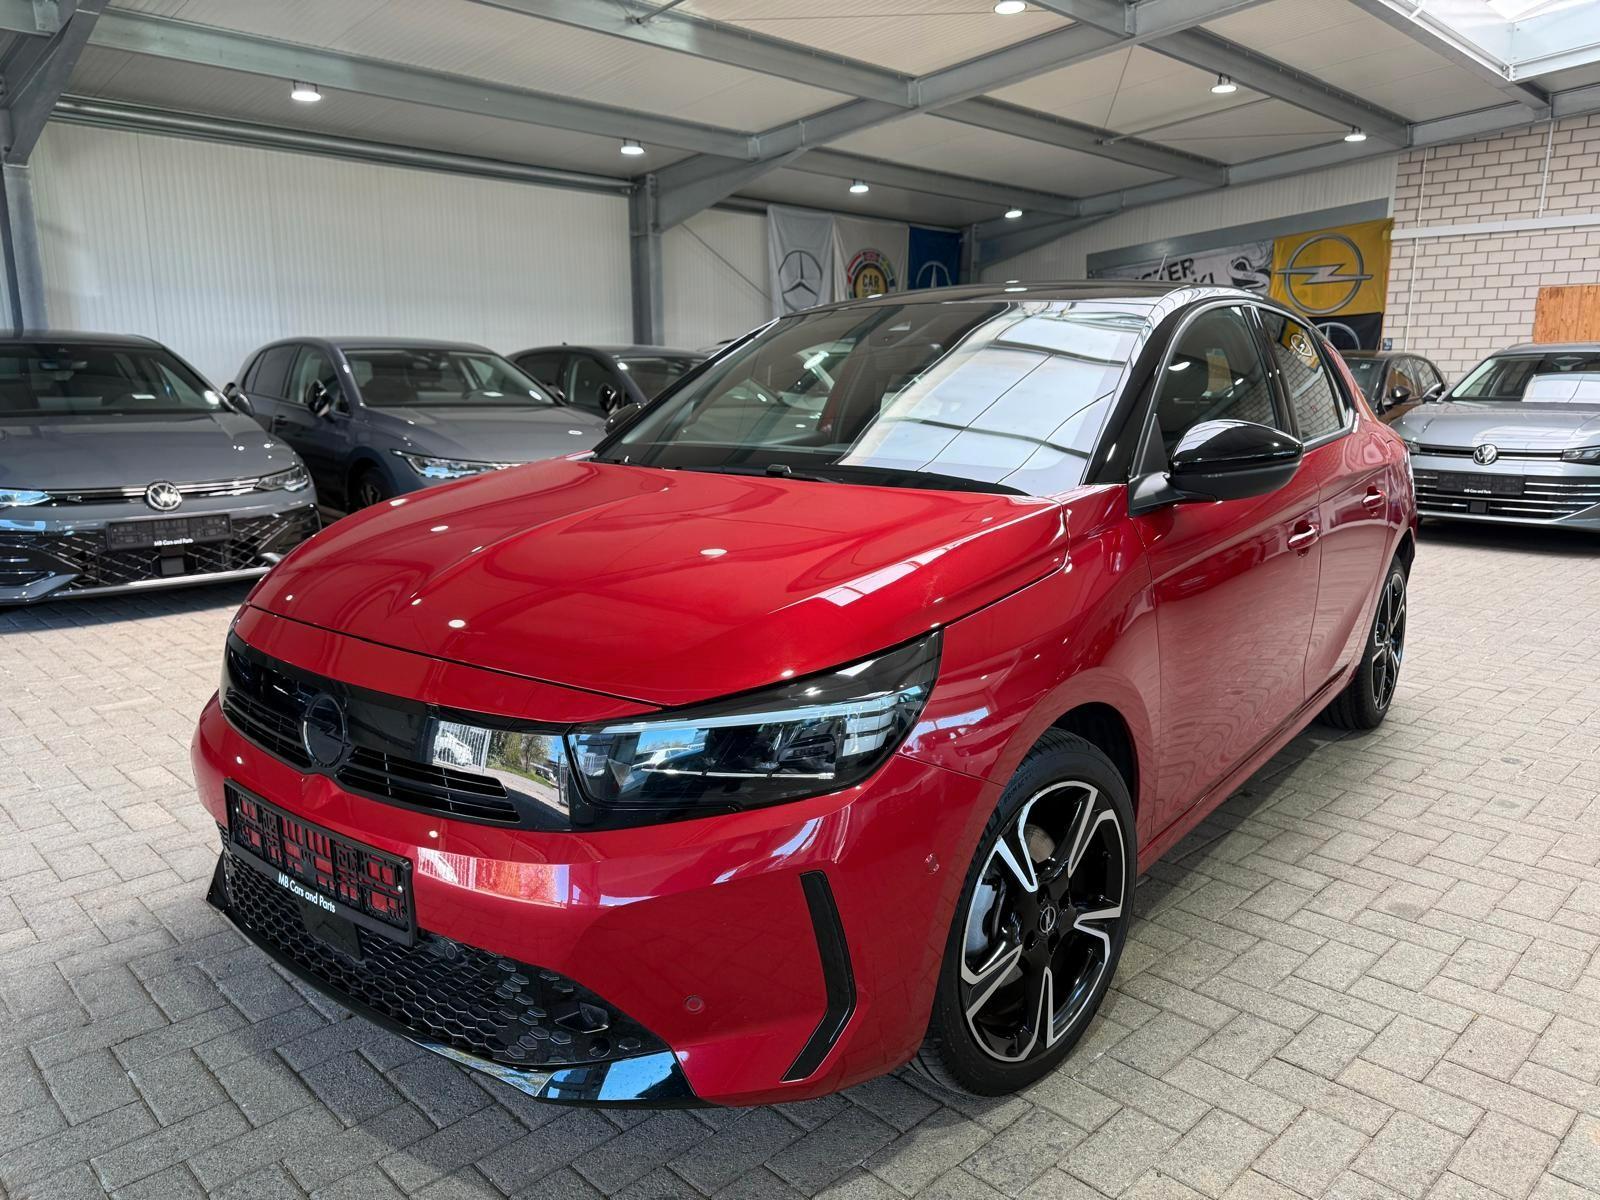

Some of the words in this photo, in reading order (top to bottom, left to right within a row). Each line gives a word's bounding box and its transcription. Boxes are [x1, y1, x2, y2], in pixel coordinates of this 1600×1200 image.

[1135, 258, 1195, 280] TER
[863, 274, 880, 289] CAR
[278, 871, 289, 888] MB
[290, 879, 304, 897] Cars
[305, 891, 318, 905] and
[319, 894, 336, 913] Parts
